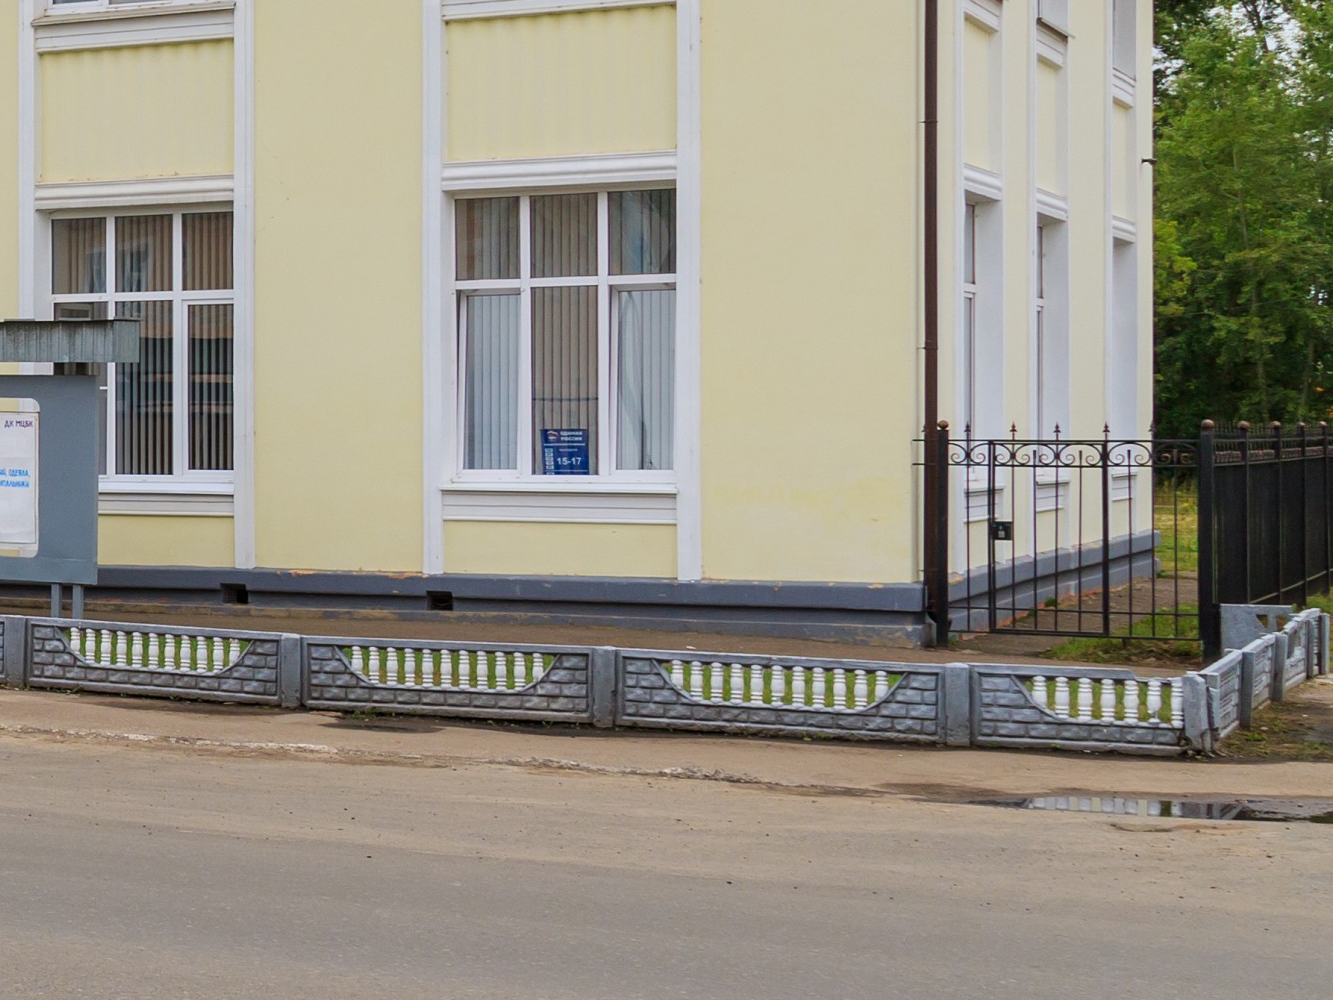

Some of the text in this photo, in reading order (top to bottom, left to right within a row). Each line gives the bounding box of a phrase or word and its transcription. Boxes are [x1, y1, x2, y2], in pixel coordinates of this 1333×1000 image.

[4, 420, 33, 428] ДК МЦБК
[557, 457, 582, 465] 15-17
